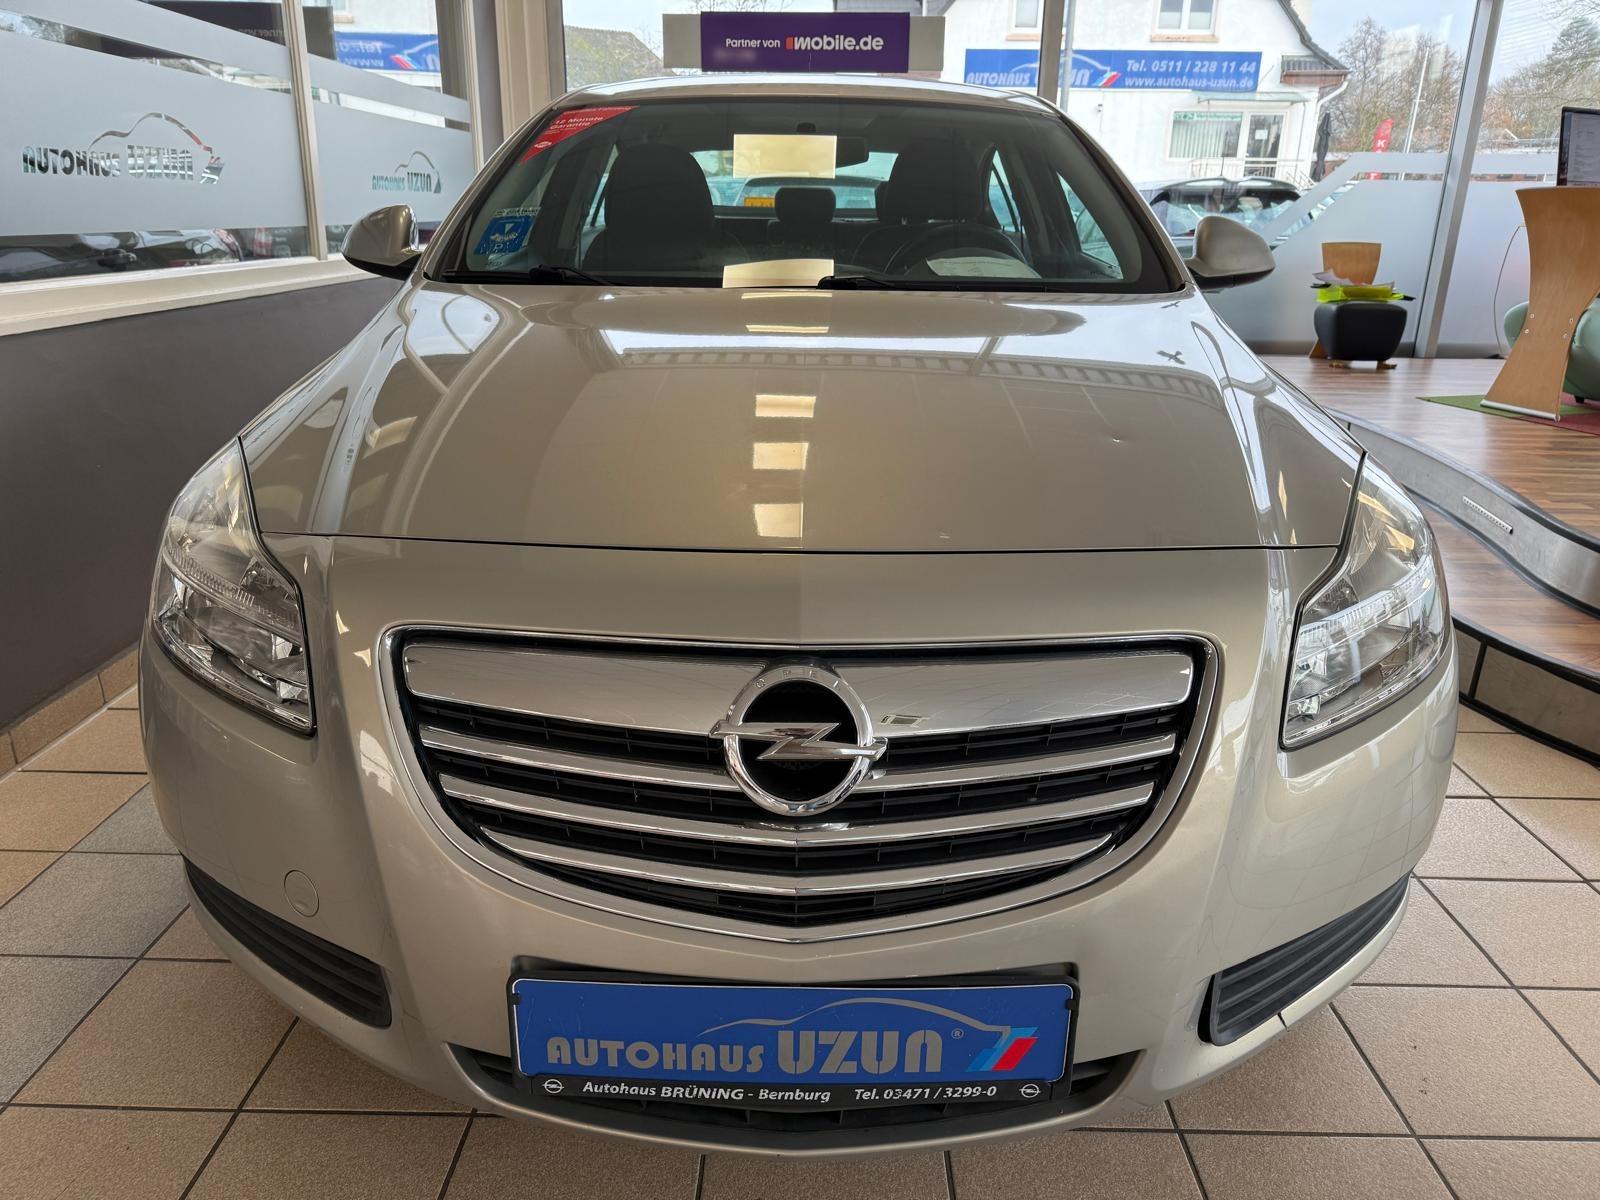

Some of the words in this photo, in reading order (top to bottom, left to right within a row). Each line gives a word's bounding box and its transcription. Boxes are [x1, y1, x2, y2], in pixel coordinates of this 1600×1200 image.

[725, 38, 761, 48] Partner
[762, 40, 780, 48] von
[793, 34, 884, 51] mobile.de
[1126, 60, 1147, 73] Tel.
[1151, 61, 1182, 73] 0511
[1193, 61, 1218, 73] 228
[1221, 62, 1237, 73] 11
[1239, 61, 1257, 73] 44
[966, 70, 1030, 86] AUTOHAUS
[1125, 75, 1254, 88] www.autohaus-uzun.de
[550, 121, 592, 130] Garantie
[568, 116, 604, 124] Monate
[22, 146, 120, 177] AUTOHAUS
[371, 175, 406, 192] AUTOHAUS
[407, 171, 432, 193] UZUN
[547, 1036, 764, 1073] AUTOHAUS
[778, 1029, 943, 1075] UZUN
[582, 1081, 656, 1096] Autohaus
[660, 1084, 744, 1100] BRÜNING
[758, 1088, 831, 1103] Bernburg
[854, 1088, 880, 1100] Tel.
[883, 1088, 930, 1100] 03471
[943, 1085, 997, 1098] 3299-0
